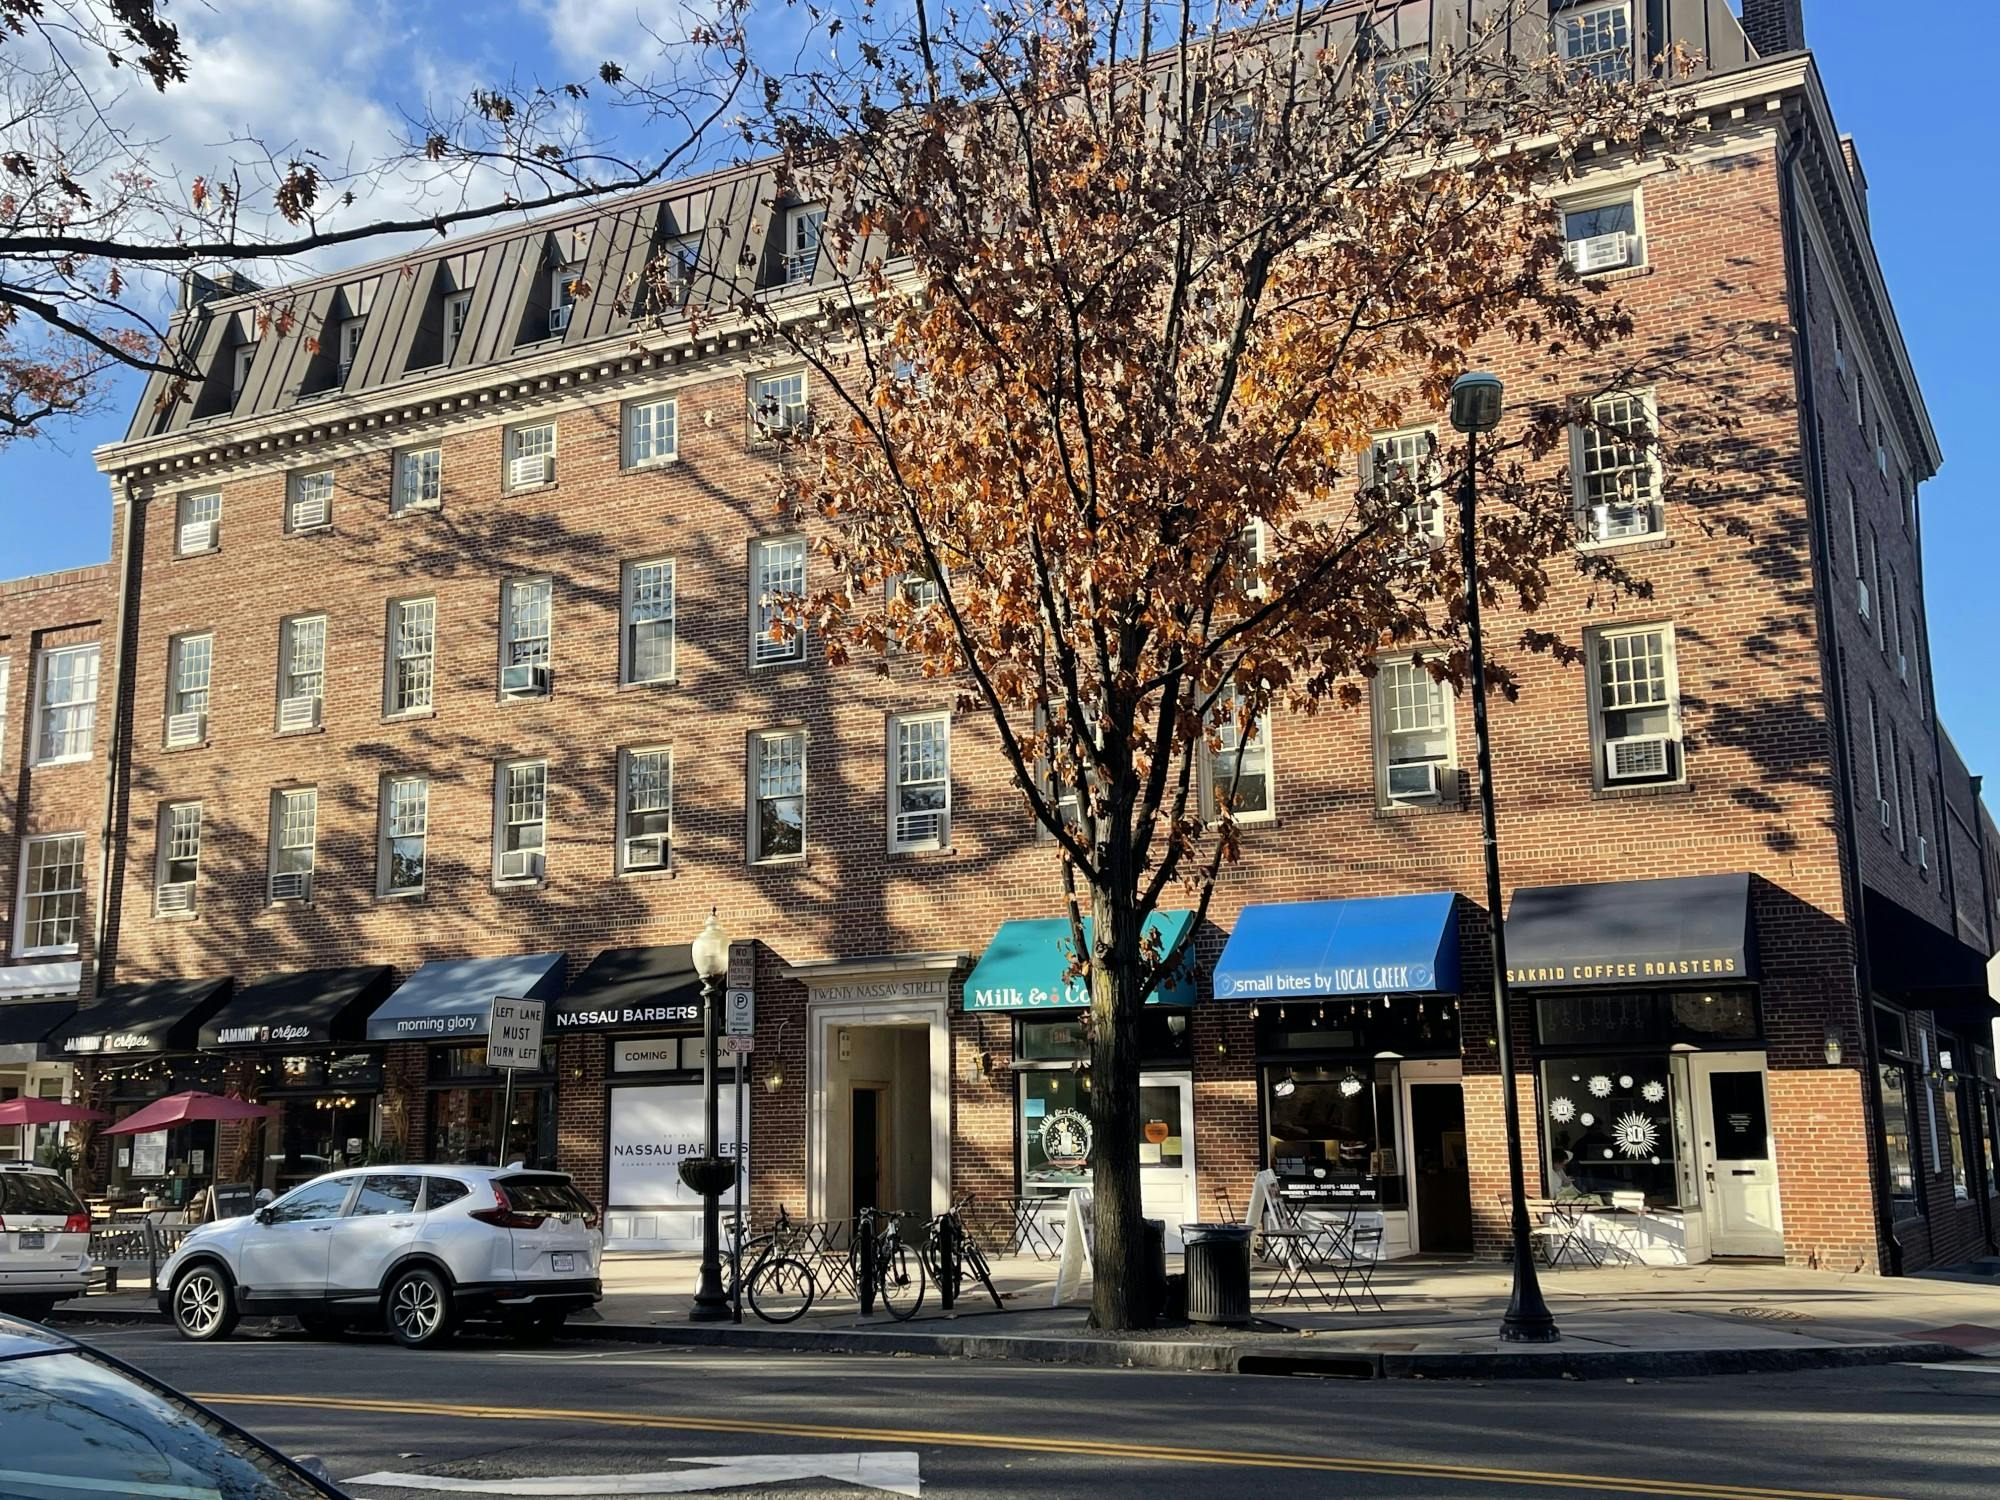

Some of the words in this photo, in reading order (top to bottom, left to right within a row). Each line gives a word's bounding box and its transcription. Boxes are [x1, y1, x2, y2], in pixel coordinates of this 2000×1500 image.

[1507, 967, 1565, 982] SAKRID
[1573, 964, 1637, 979] COFFEE
[1645, 958, 1735, 976] ROASTERS
[1236, 976, 1273, 992] small
[1277, 974, 1312, 990] bites
[1315, 973, 1332, 992] by
[1335, 968, 1370, 991] LOCAL
[1373, 966, 1409, 989] GREEK
[813, 986, 855, 1000] TWENTY
[902, 980, 945, 995] STREET
[974, 988, 1023, 1007] Milk
[1028, 988, 1048, 1005] &
[496, 1007, 514, 1019] LEFT
[520, 1009, 541, 1022] LANE
[556, 1010, 619, 1026] NASSAU
[623, 1006, 698, 1022] BARBERS
[398, 1017, 444, 1032] morning
[448, 1016, 477, 1032] glory
[218, 1027, 259, 1043] JAMMIN'
[272, 1025, 310, 1040] crêpes
[502, 1026, 531, 1041] MUST
[492, 1046, 514, 1058] TURN
[518, 1047, 537, 1059] LEFT
[625, 1051, 668, 1061] COMING
[614, 1144, 672, 1156] NASSAU
[678, 1142, 748, 1155] BARERS
